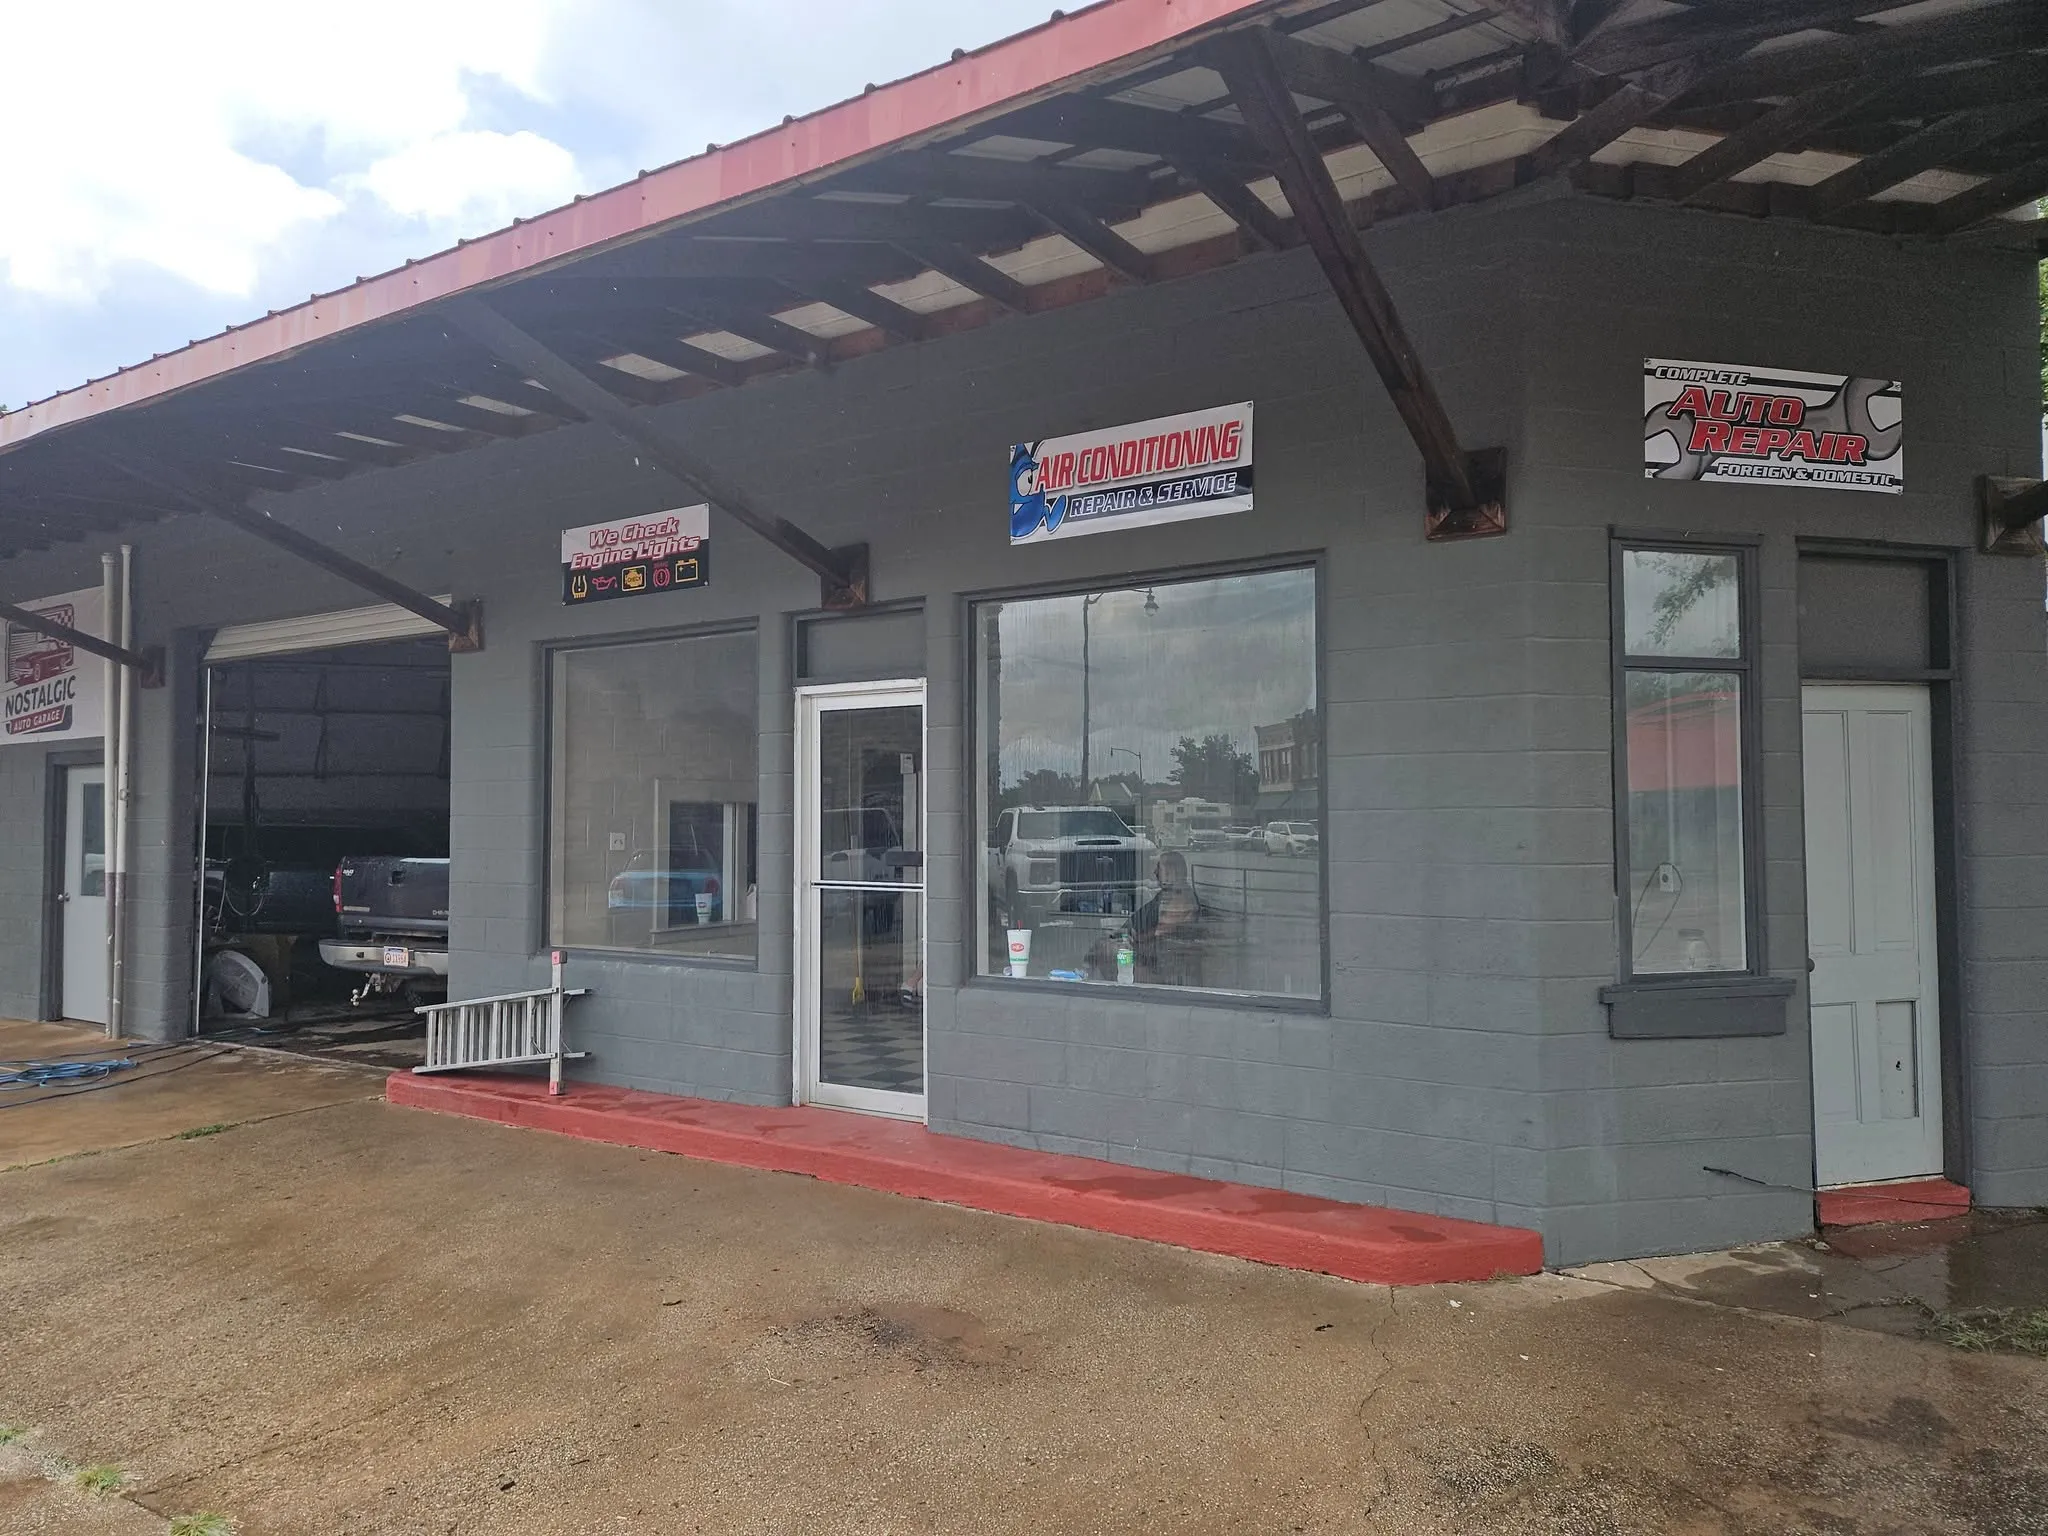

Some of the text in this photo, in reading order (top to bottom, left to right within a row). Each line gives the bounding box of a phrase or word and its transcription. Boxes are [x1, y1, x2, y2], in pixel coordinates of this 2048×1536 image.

[1655, 366, 1750, 386] COMPLETE
[1666, 385, 1805, 427] AUTO
[1034, 420, 1241, 492] AIR CONDITIONING
[1688, 419, 1868, 464] REPAIR
[1716, 463, 1896, 487] FOREIGN & DOMESTIC
[1069, 472, 1237, 518] REPAIR & SERVICE
[590, 517, 680, 549] We Check
[570, 536, 700, 570] Engine Lights
[5, 675, 76, 718] NOSTALGIC
[14, 709, 61, 731] AUTO GARAGE
